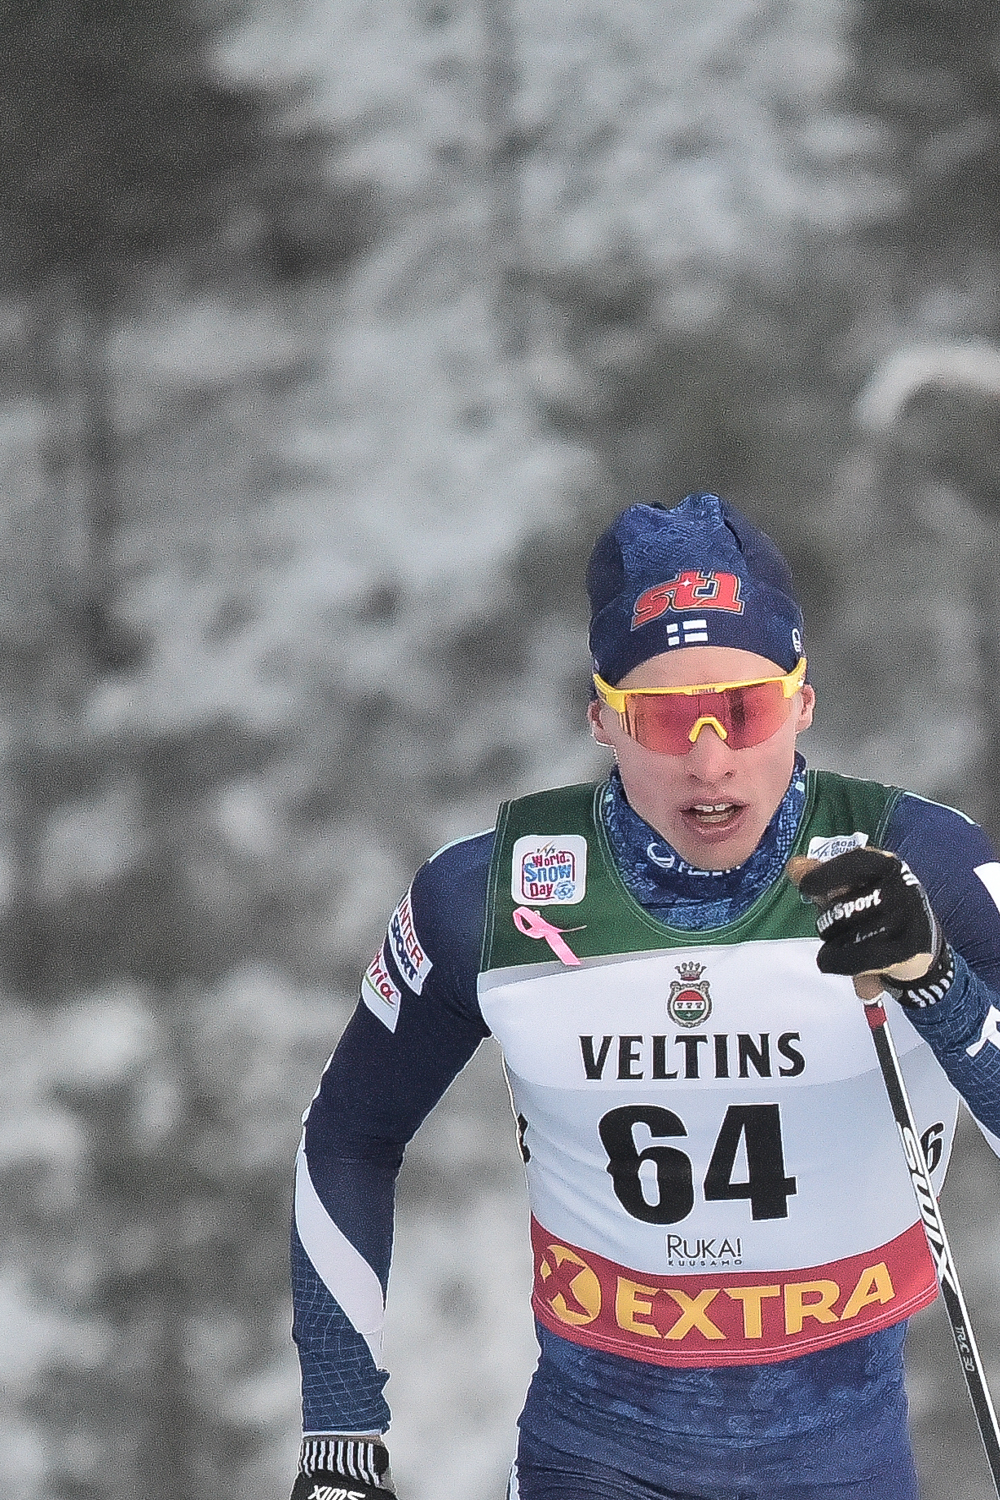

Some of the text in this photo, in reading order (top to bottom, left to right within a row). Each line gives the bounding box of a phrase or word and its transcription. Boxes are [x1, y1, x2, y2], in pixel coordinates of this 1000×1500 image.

[530, 882, 553, 897] Day
[578, 1032, 806, 1081] VELTINS
[598, 1103, 797, 1226] 64
[668, 1259, 743, 1267] KUUSAMO
[616, 1261, 895, 1340] EXTRA
